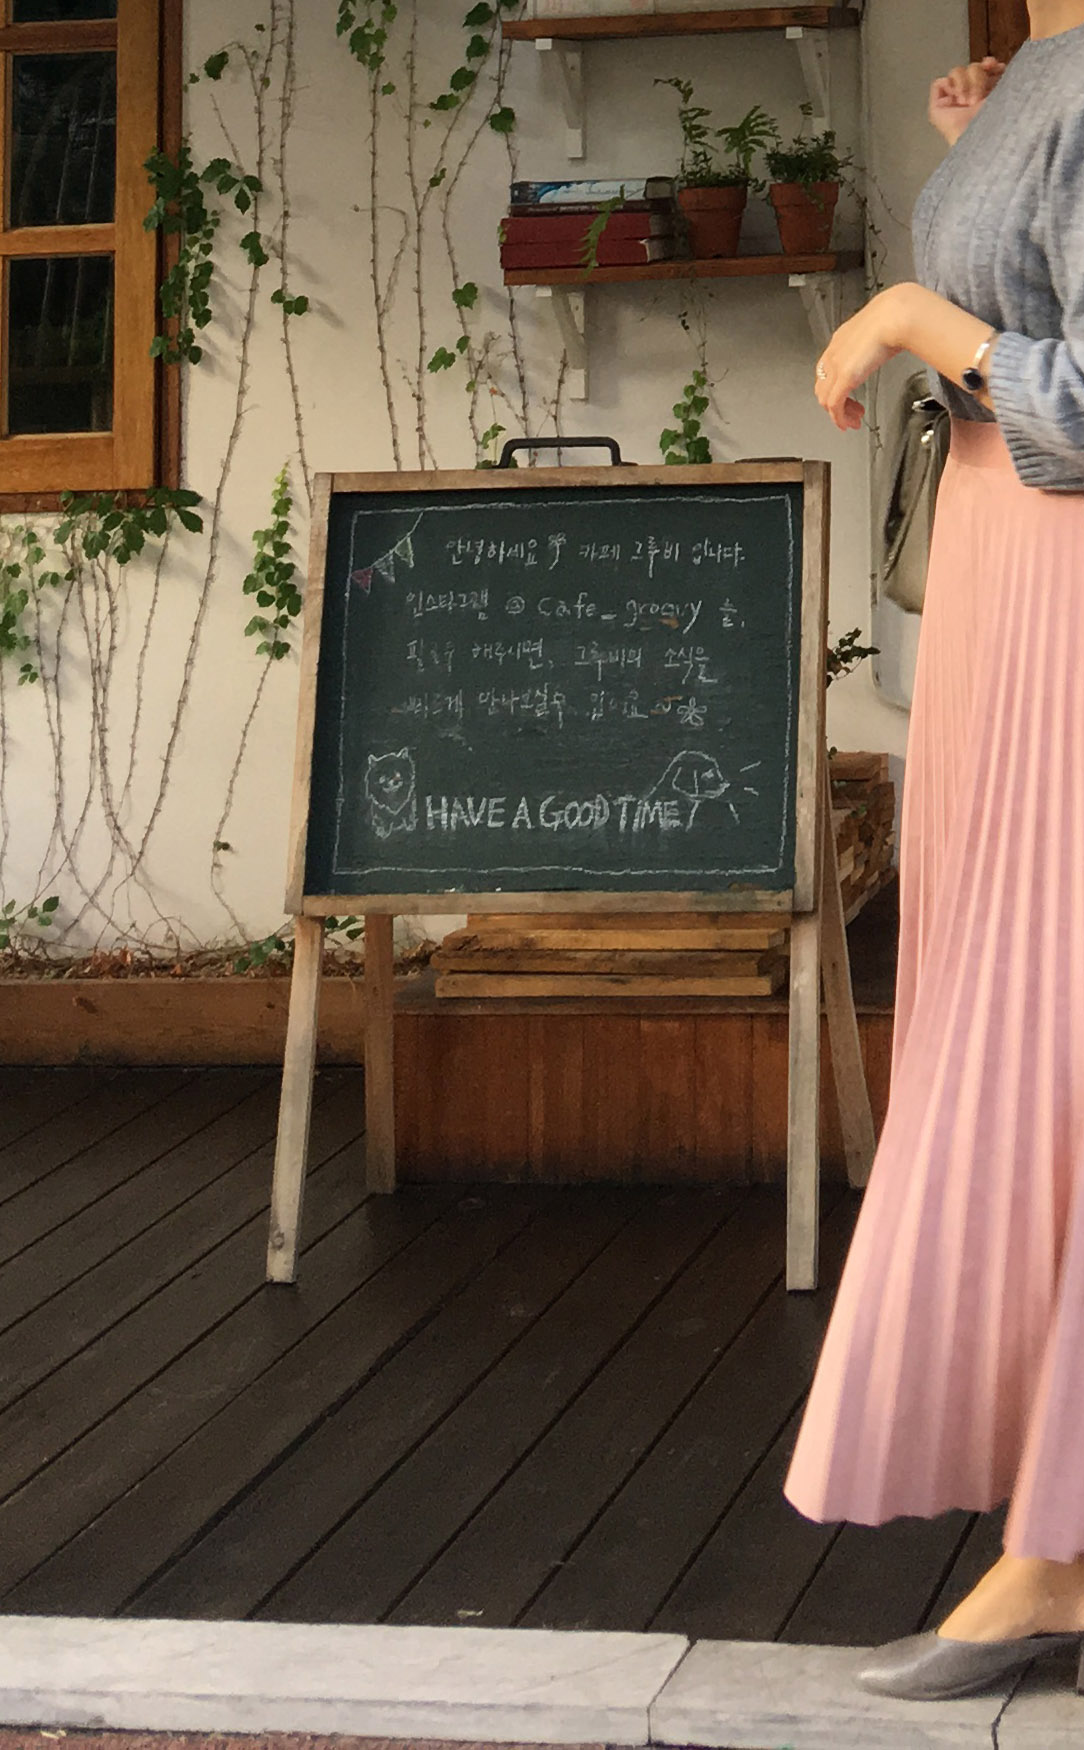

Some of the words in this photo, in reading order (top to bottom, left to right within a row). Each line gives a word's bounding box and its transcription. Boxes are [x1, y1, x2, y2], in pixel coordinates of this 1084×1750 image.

[446, 537, 538, 566] 안녕하세요
[578, 542, 621, 563] 카페
[630, 536, 681, 579] 그루비
[406, 588, 489, 622] 인스타그램
[663, 645, 719, 683] 소식을
[426, 796, 505, 830] HAVE
[512, 797, 535, 830] A
[539, 795, 610, 831] GOOD
